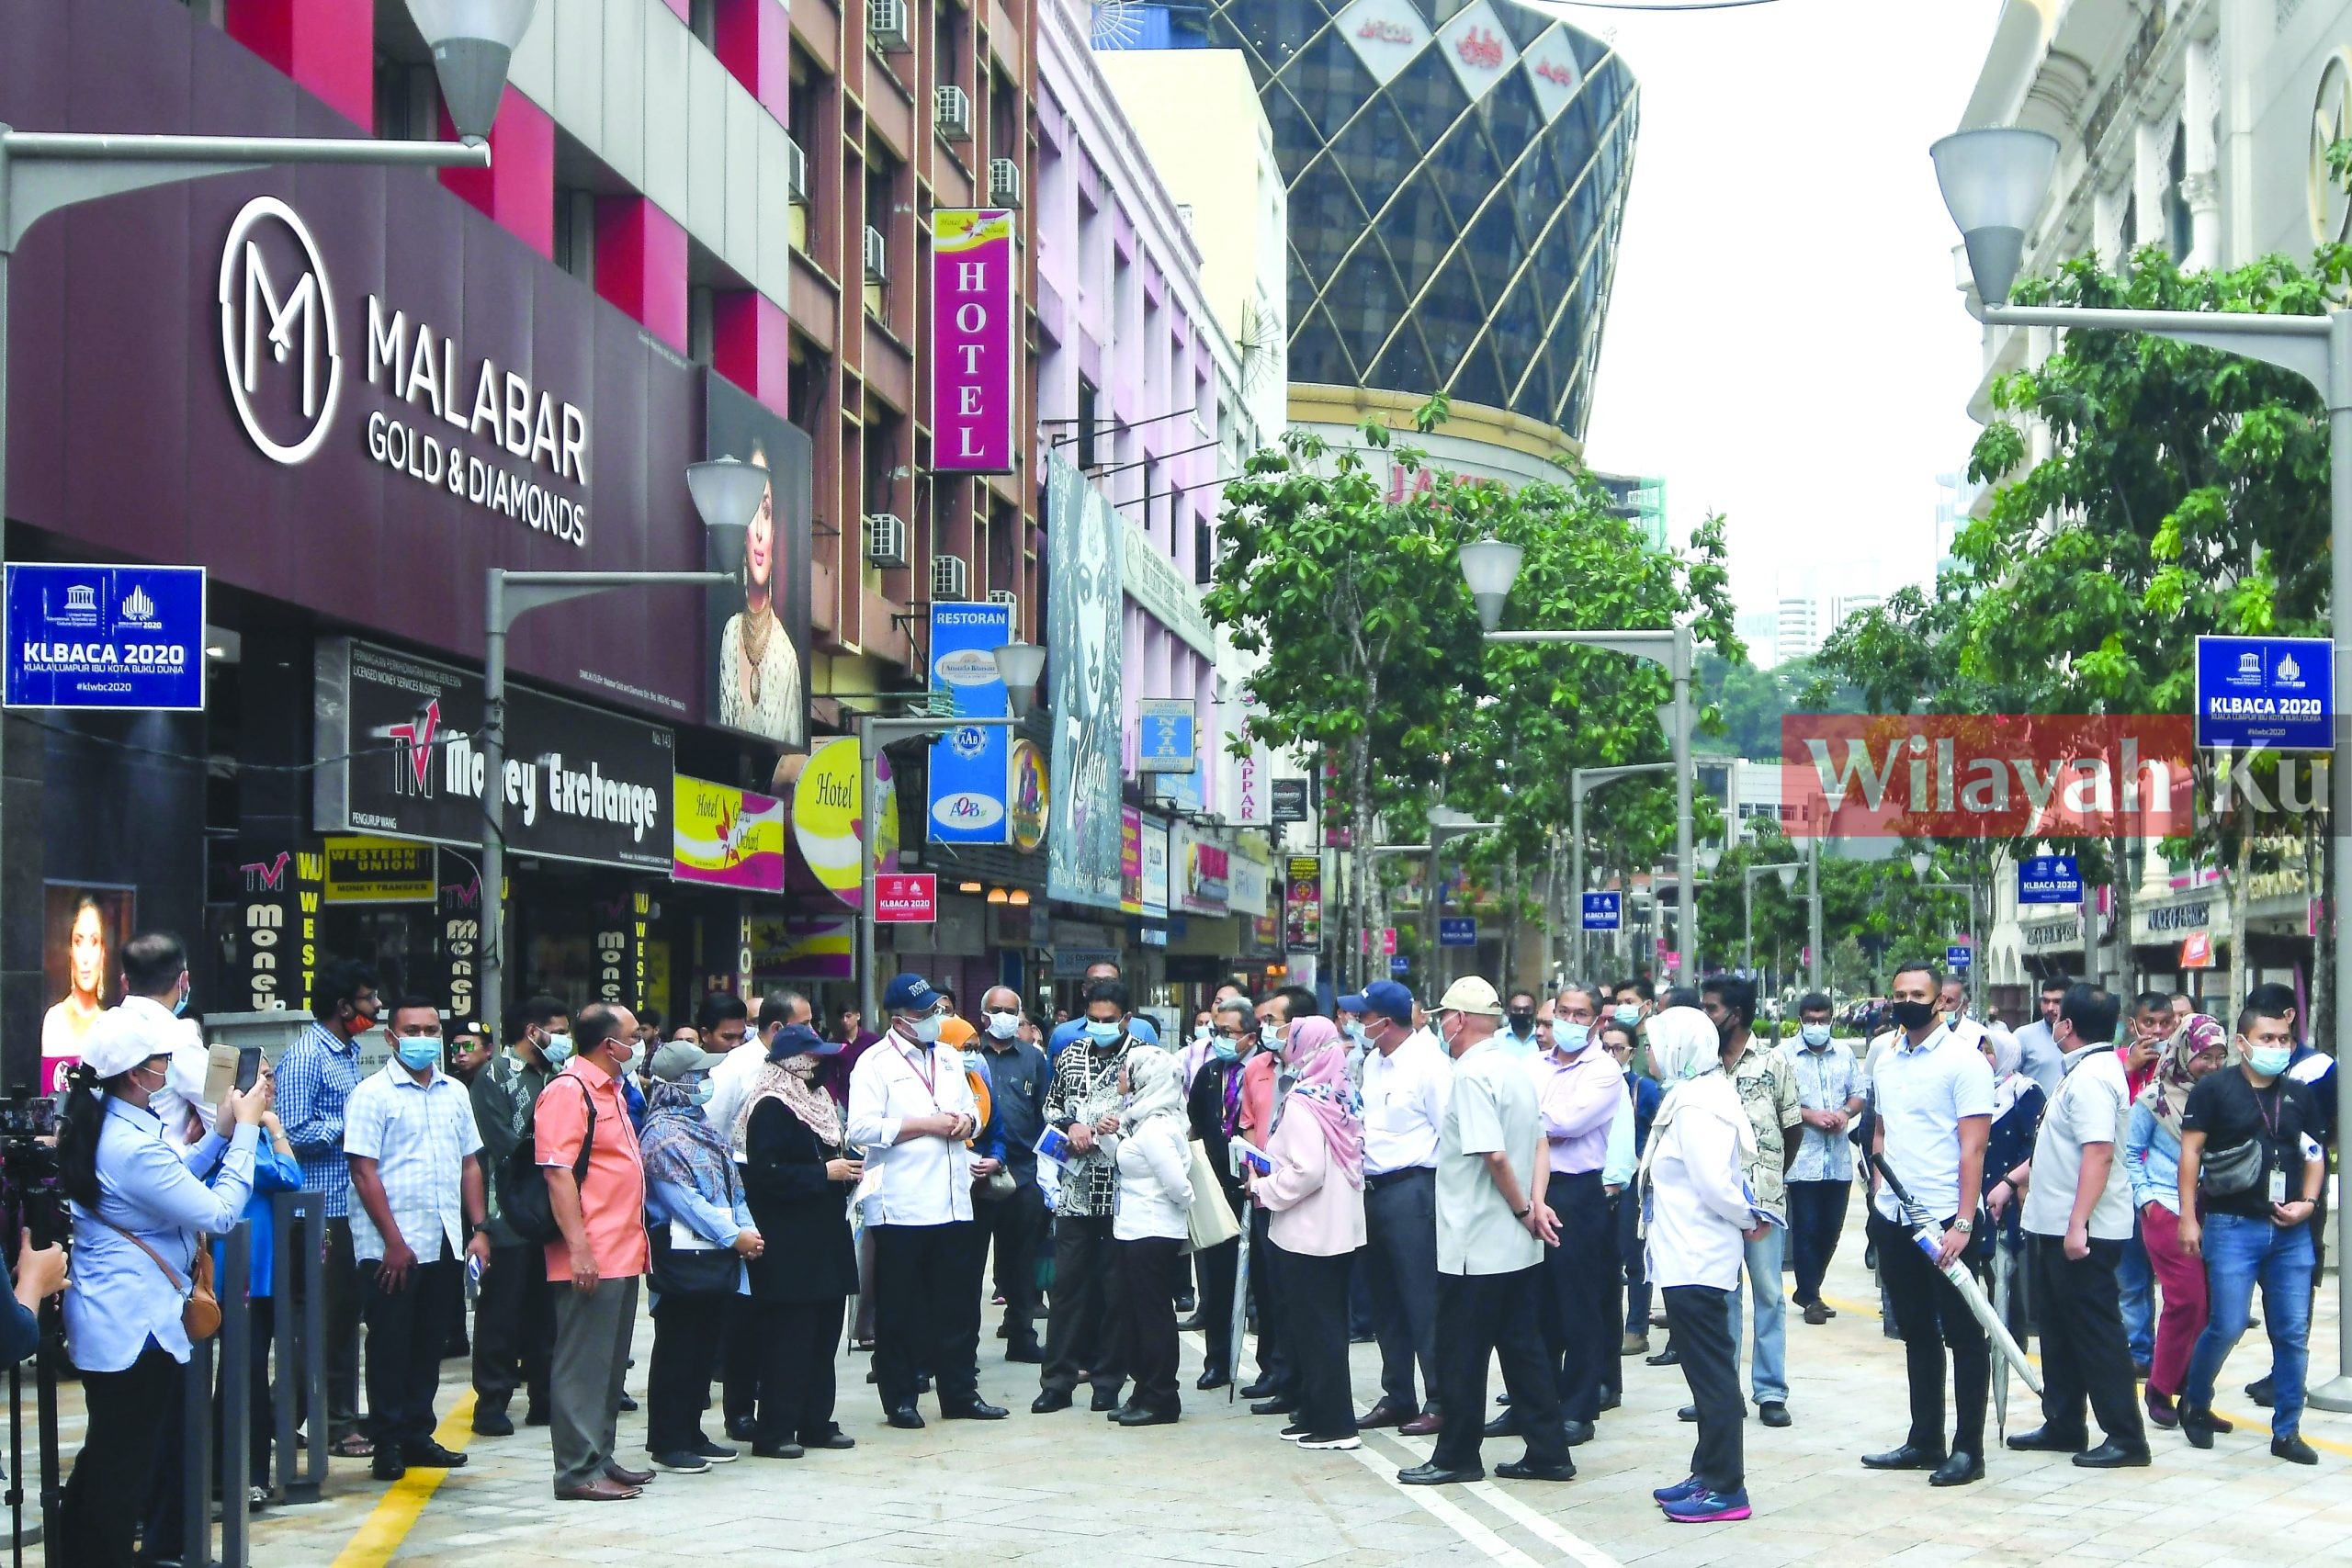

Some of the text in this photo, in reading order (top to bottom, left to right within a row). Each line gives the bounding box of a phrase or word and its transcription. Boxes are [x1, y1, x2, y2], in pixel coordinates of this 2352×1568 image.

[956, 262, 989, 457] HOTEL
[368, 293, 586, 486] MALABAR
[368, 410, 586, 548] GOLD & DIAMONDS
[936, 613, 1006, 625] RESTORAN
[24, 643, 185, 665] KLBACA 2020
[24, 664, 52, 672] KUALA
[54, 664, 90, 672] LUMPUR
[92, 665, 106, 673] IBU
[107, 665, 130, 673] KOTA
[157, 666, 184, 674] DUNIA
[77, 682, 131, 692] #klwbc2020
[2211, 697, 2322, 715] KLBACA 2020
[446, 728, 658, 843] Moey Exchange
[815, 772, 855, 810] Hotel
[695, 794, 720, 818] Hotel
[949, 795, 981, 818] A2B
[352, 811, 397, 829] PENGURUP WANG
[331, 849, 415, 861] WESTERN
[358, 860, 415, 871] UNION
[337, 883, 427, 892] MONEY TRANSFER
[2023, 880, 2077, 889] KLBACA 2020
[879, 898, 930, 908] KLBACA 2020
[447, 919, 478, 1017] money
[597, 931, 625, 1003] mone
